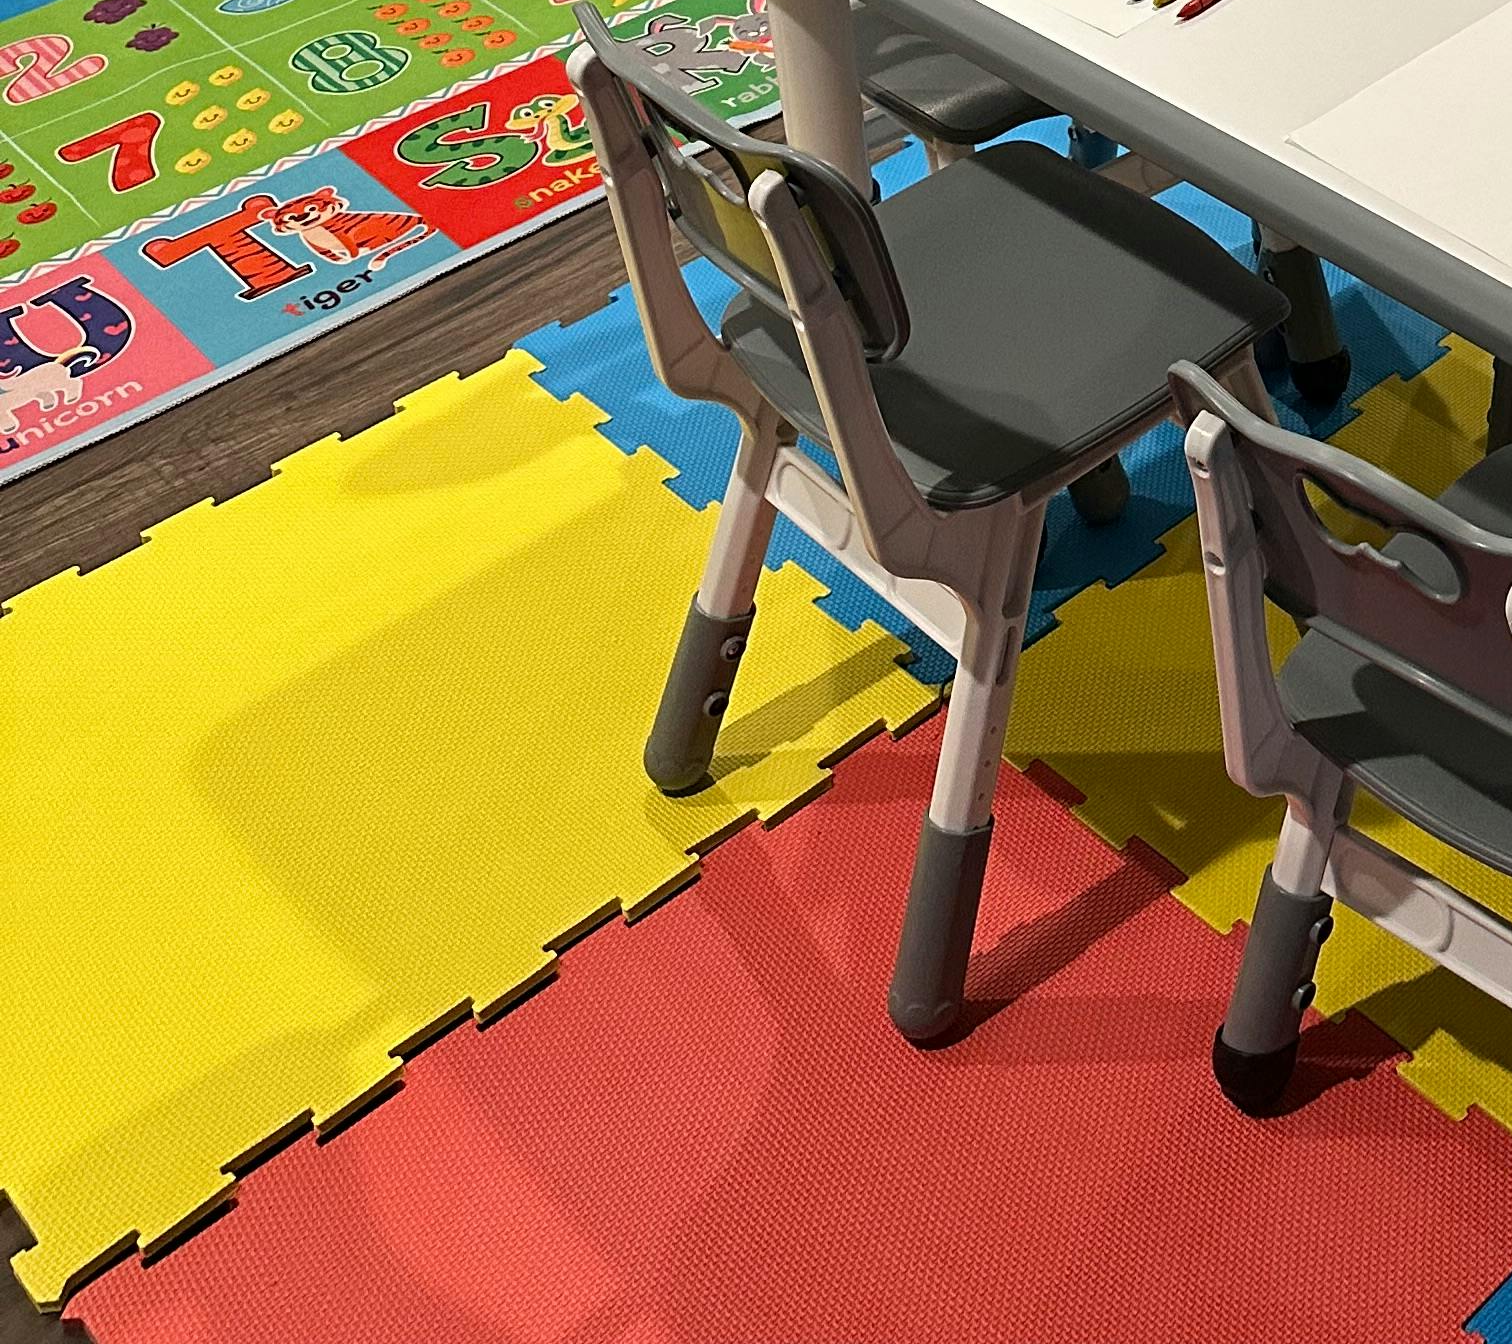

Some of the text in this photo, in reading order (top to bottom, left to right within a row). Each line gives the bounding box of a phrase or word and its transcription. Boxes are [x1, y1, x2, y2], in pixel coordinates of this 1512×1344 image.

[0, 34, 108, 105] 2
[289, 31, 412, 95] 8
[55, 110, 165, 193] 7
[394, 104, 541, 190] S
[514, 162, 600, 209] snake
[139, 195, 316, 300] T
[0, 276, 135, 378] U
[281, 268, 374, 316] tiger
[0, 380, 143, 454] unicorn
